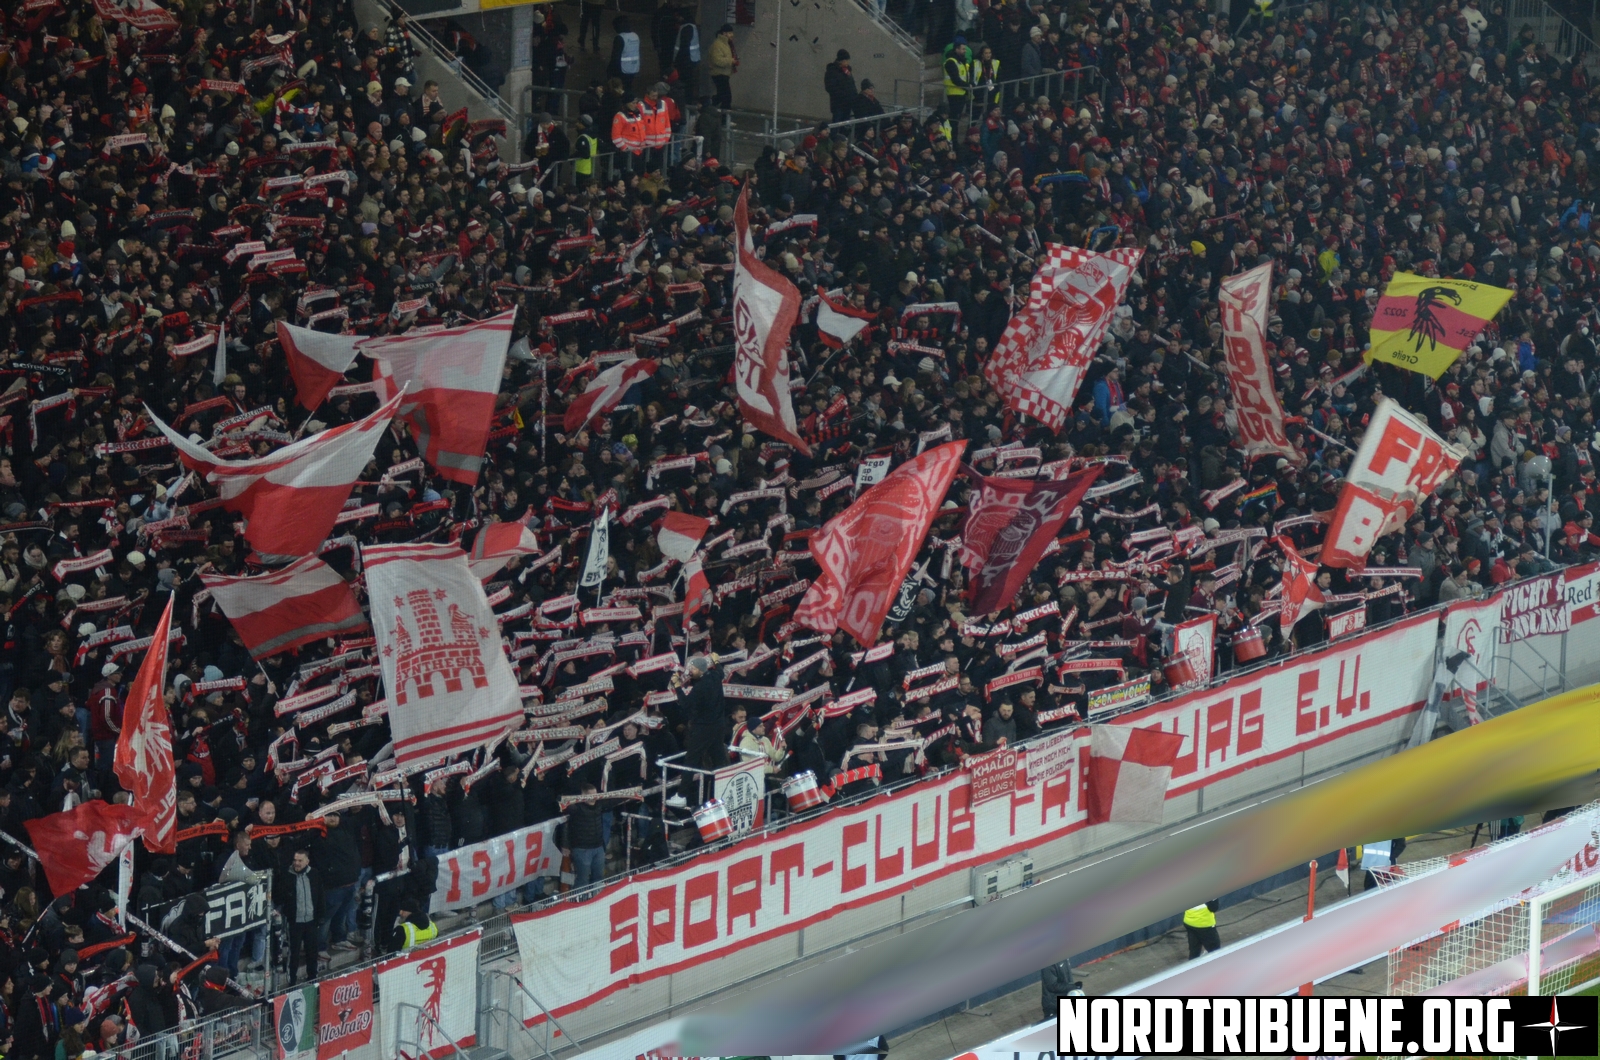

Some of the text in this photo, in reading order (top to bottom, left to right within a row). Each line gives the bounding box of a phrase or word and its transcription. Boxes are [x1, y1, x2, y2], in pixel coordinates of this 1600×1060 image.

[1502, 578, 1552, 618] FIGHT
[1568, 579, 1592, 605] Red
[395, 655, 484, 682] SYNTHESIA
[196, 677, 244, 692] FREIBURG
[906, 676, 958, 702] SPORT-CLUB
[1045, 735, 1064, 749] LIEBEN
[973, 754, 1014, 778] KHALID
[973, 770, 1015, 789] FÜR IMMER
[978, 783, 1009, 798] BEI UNS
[444, 830, 549, 904] 13.12.
[609, 784, 977, 975] SPORT-CLUB
[333, 980, 361, 1006] Città
[320, 1009, 372, 1044] Nostra79
